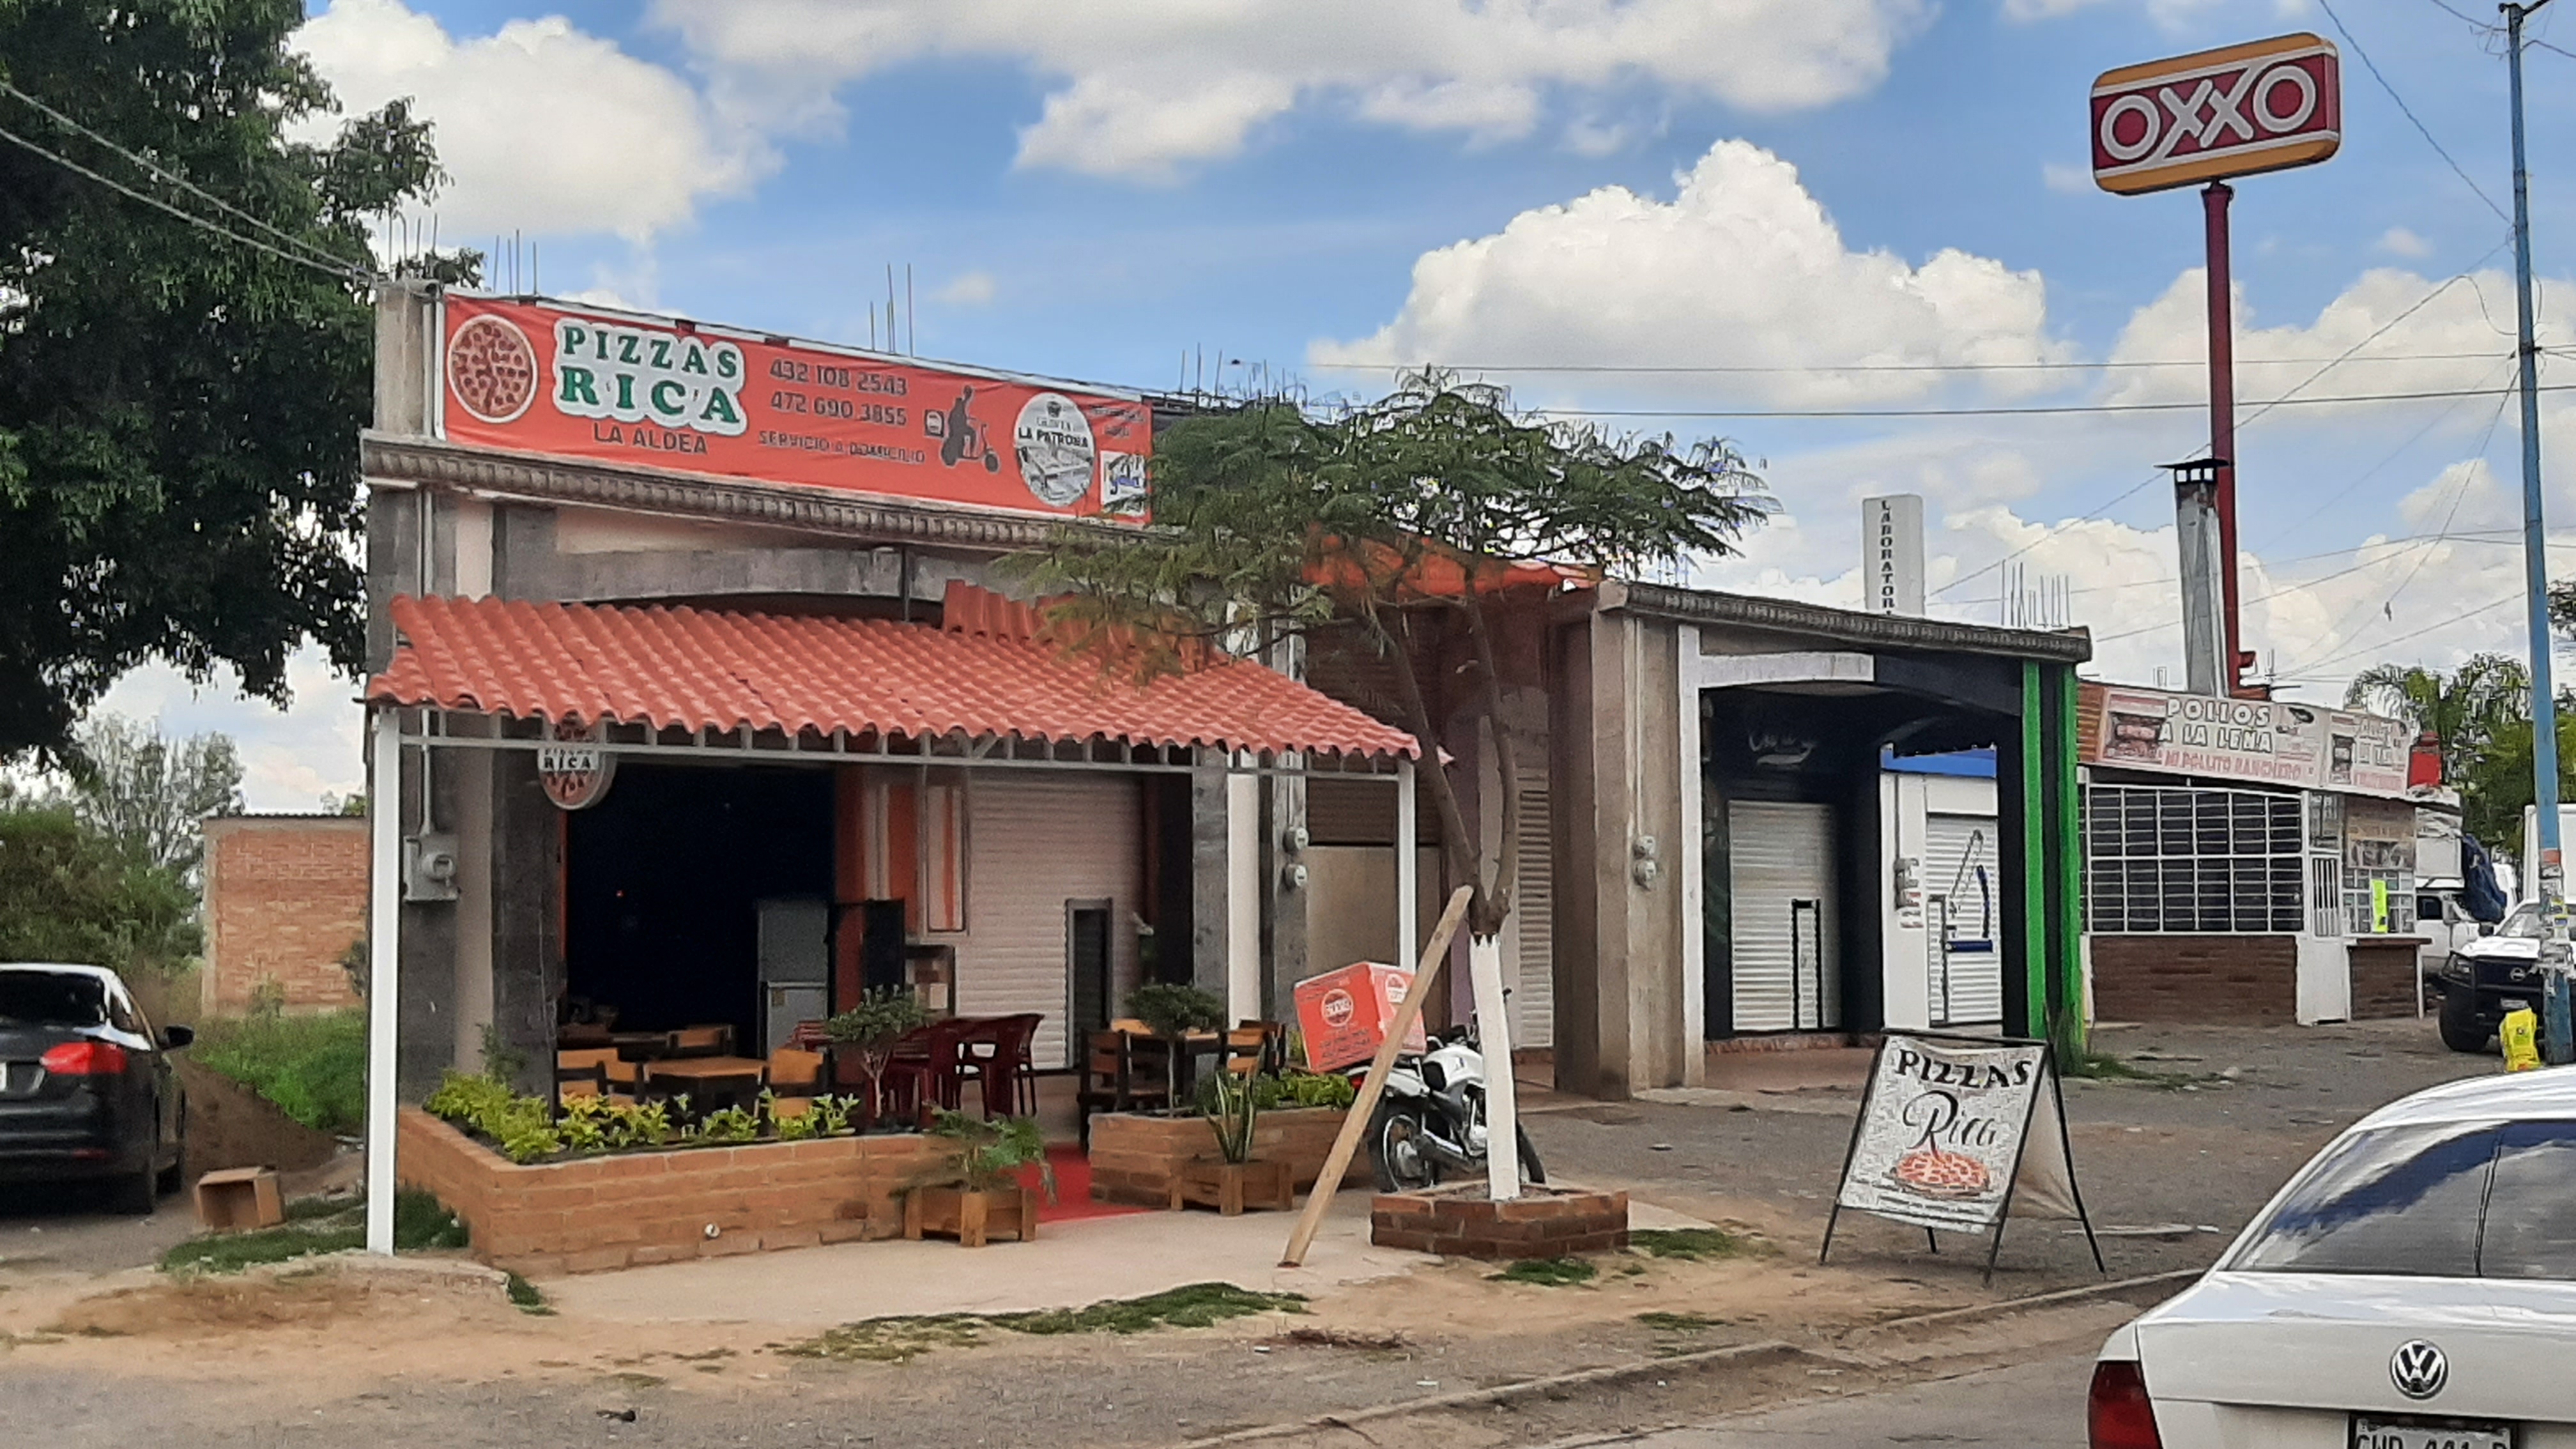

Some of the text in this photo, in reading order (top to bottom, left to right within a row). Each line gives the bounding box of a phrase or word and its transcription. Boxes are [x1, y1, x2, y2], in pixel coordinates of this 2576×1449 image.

[2100, 64, 2317, 164] OXXO
[562, 325, 739, 378] PIZZAS
[560, 365, 740, 424] RICA
[770, 358, 908, 396] 432 108 2543
[770, 390, 907, 425] 472 690 3855
[594, 422, 709, 454] LA ALDEA
[1018, 427, 1032, 440] LA
[2166, 697, 2271, 728] POLLOS
[2158, 721, 2173, 742] A
[2182, 723, 2208, 746] LA
[544, 756, 591, 769] RICA
[1894, 1048, 2033, 1089] PIZZAS
[1903, 1089, 1998, 1162] Rica
